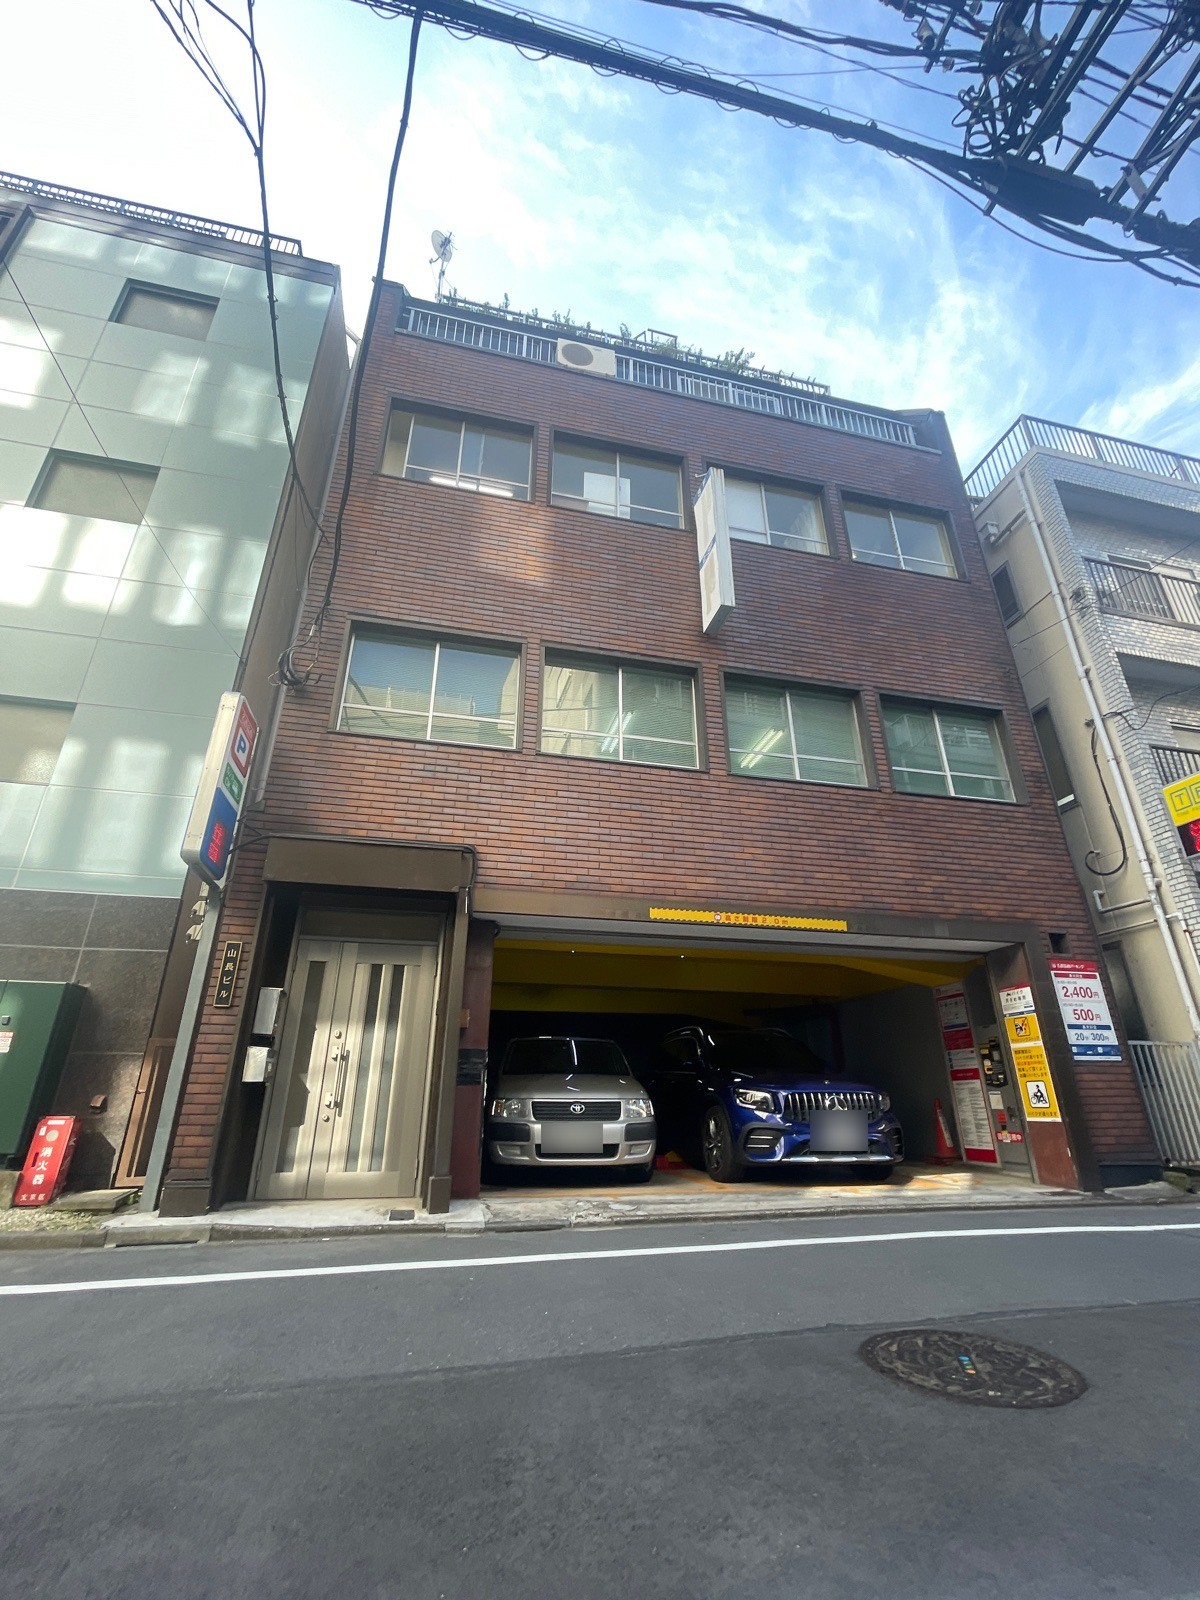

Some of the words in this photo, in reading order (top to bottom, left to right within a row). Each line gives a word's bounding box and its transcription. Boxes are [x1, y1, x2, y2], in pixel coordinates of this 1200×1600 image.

[237, 734, 247, 754] P
[219, 948, 237, 998] 山長ビル
[1062, 985, 1100, 999] 2,400円
[1073, 1008, 1102, 1022] 500円
[1090, 1033, 1110, 1042] 300円
[31, 1146, 54, 1186] 消火器
[19, 1192, 46, 1202] 文京区
